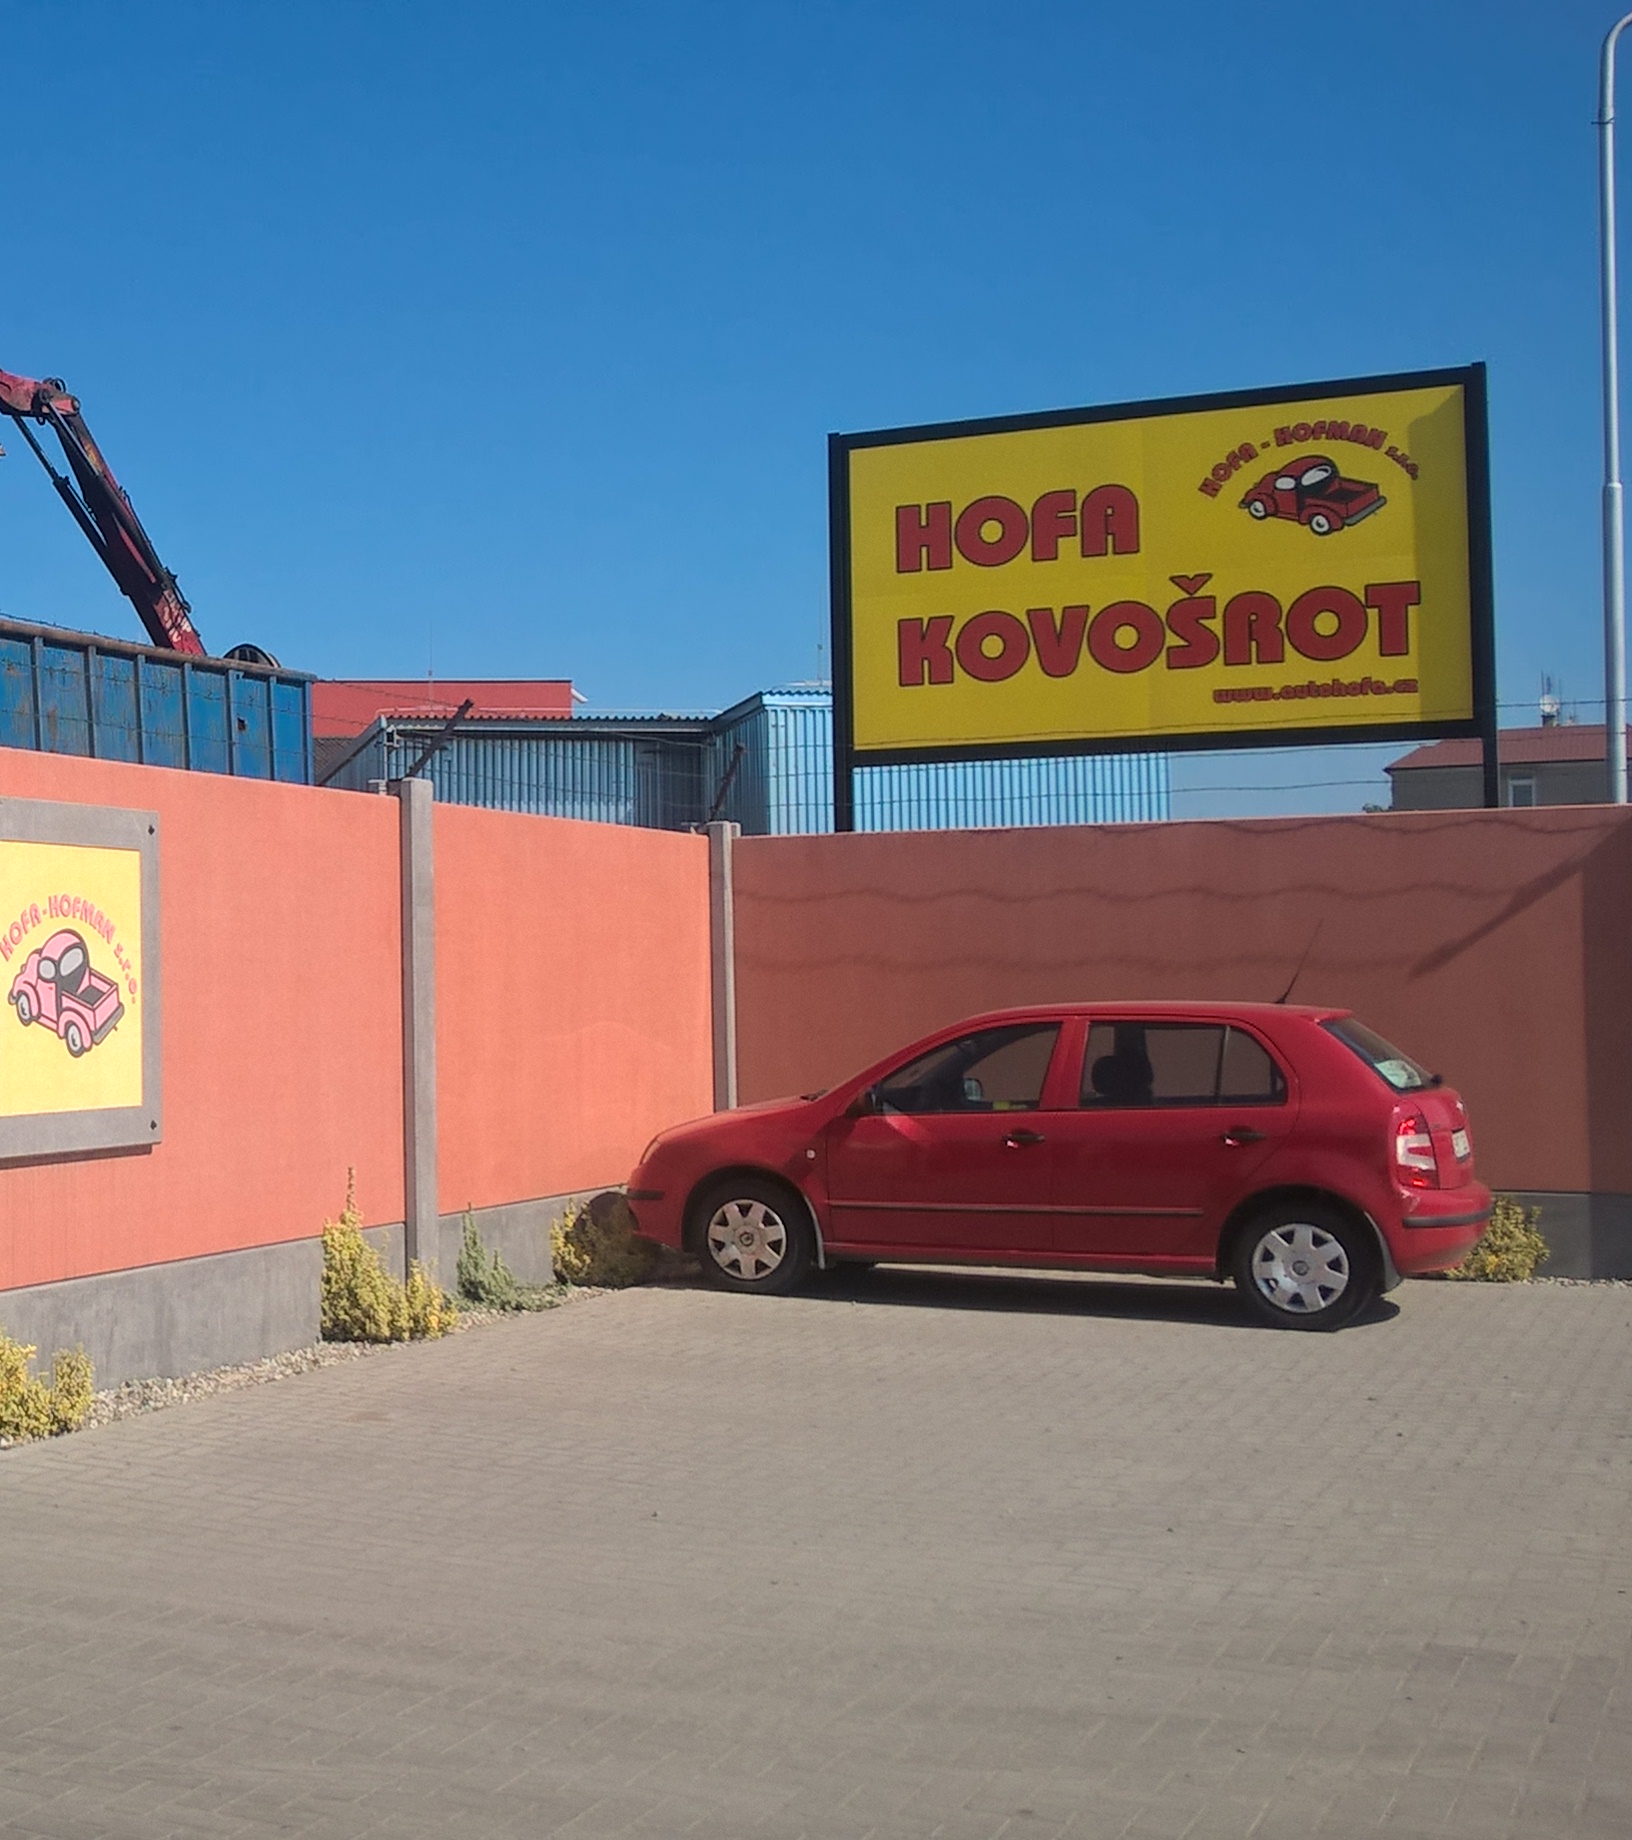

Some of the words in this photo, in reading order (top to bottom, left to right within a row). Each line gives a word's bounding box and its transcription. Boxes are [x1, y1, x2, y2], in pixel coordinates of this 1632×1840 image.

[1198, 442, 1259, 498] HOFA
[1273, 420, 1388, 450] HOFMAN
[895, 484, 1140, 573] HOFA
[898, 572, 1421, 687] KOVOŠROT
[1213, 677, 1418, 703] www.autohofa.cz
